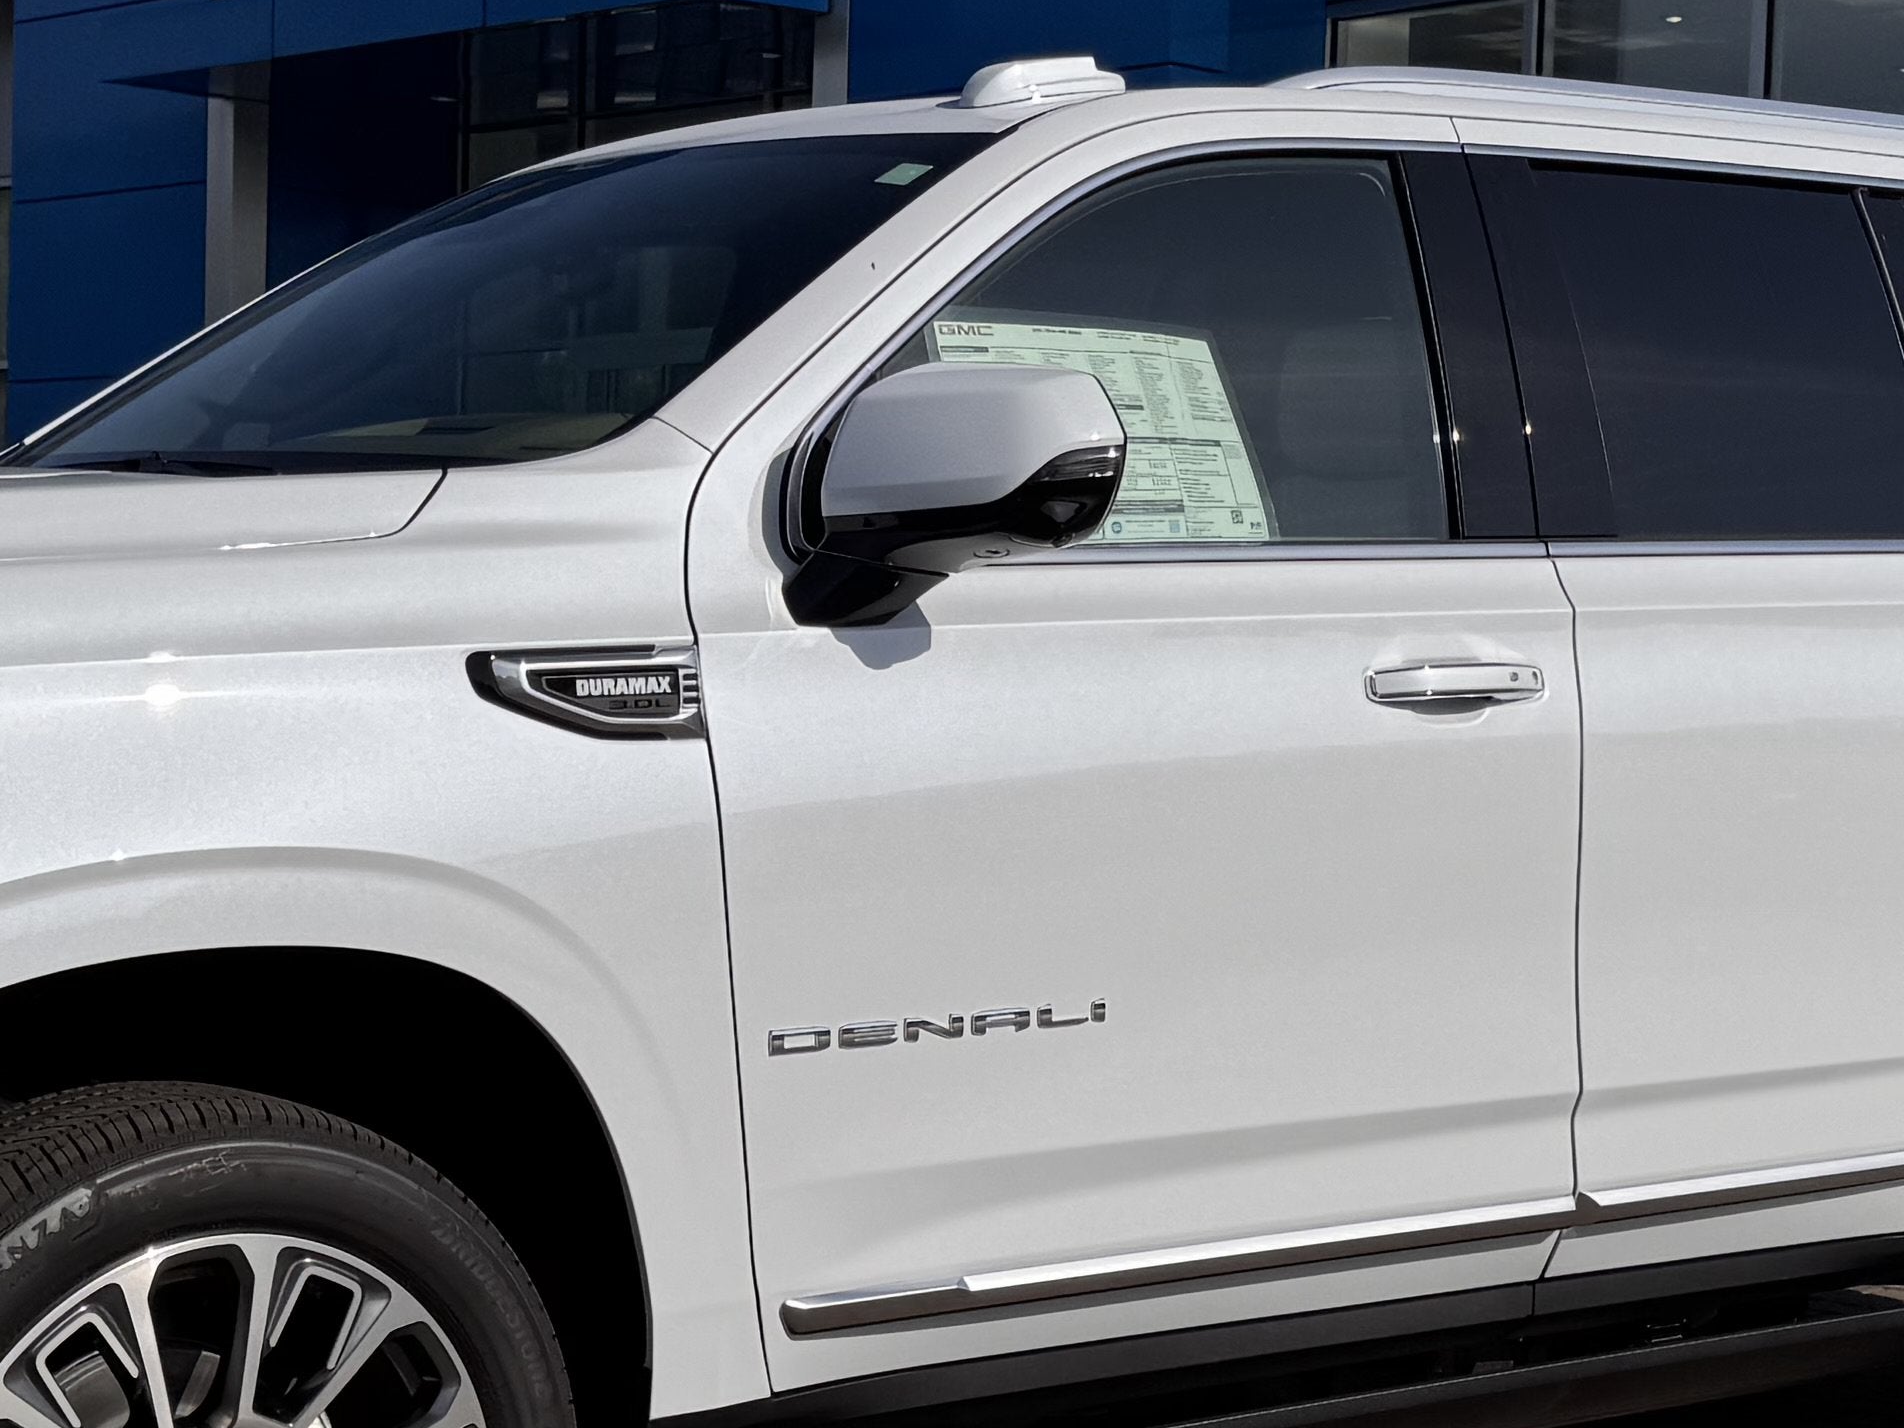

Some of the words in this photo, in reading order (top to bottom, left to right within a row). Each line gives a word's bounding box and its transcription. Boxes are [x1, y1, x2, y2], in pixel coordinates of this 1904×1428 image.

[938, 323, 994, 337] GMC
[575, 675, 672, 697] DURAMAX
[767, 997, 1107, 1058] DENALI
